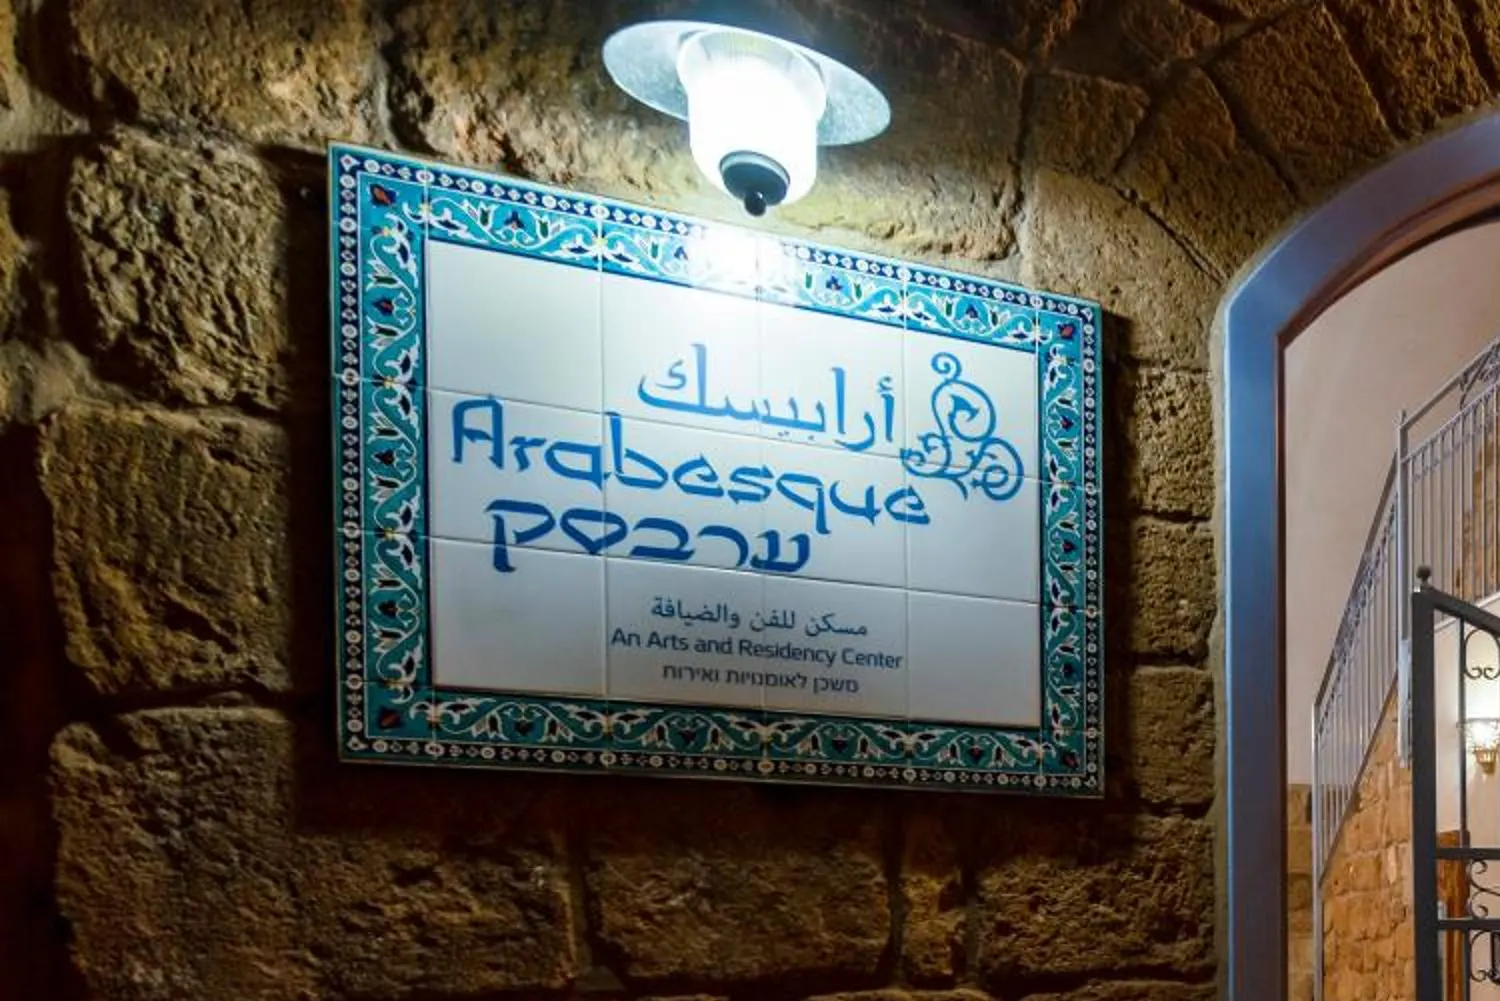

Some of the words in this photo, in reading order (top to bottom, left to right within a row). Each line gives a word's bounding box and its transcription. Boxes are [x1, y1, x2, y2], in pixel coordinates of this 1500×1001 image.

[638, 343, 895, 453] أرابيسك
[452, 395, 931, 535] Arabesque
[486, 499, 811, 573] ערבסק
[651, 597, 741, 629] والضيافة
[749, 609, 796, 632] للفن
[804, 612, 868, 637] مسكن
[611, 628, 641, 648] An
[647, 631, 689, 651] Arts
[694, 636, 733, 654] and
[739, 639, 837, 668] Residency
[841, 648, 904, 669] Center
[662, 664, 719, 683] ואירוח
[812, 676, 860, 694] משכן
